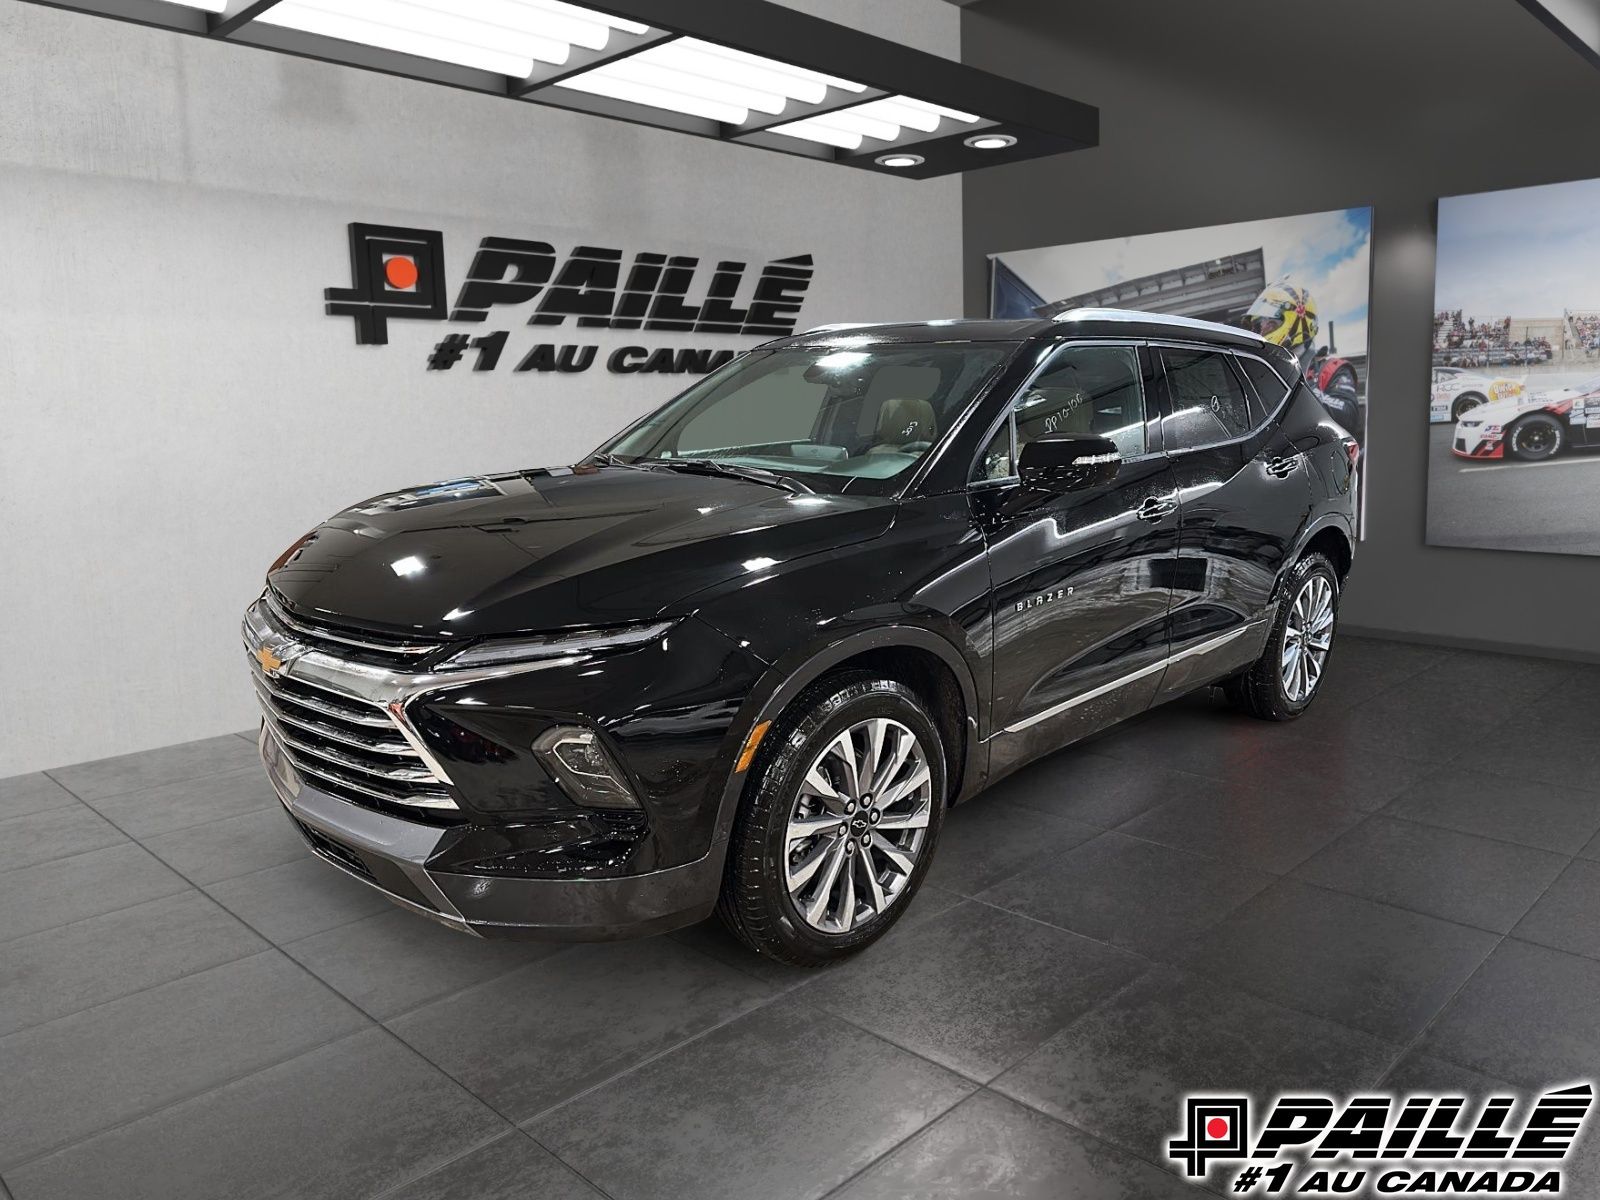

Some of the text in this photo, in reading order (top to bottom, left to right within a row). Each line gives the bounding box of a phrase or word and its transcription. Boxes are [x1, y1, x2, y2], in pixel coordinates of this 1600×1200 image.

[448, 236, 814, 336] PAILLÉ
[427, 331, 750, 374] #1 AU CANA
[1016, 586, 1074, 612] BLAZER
